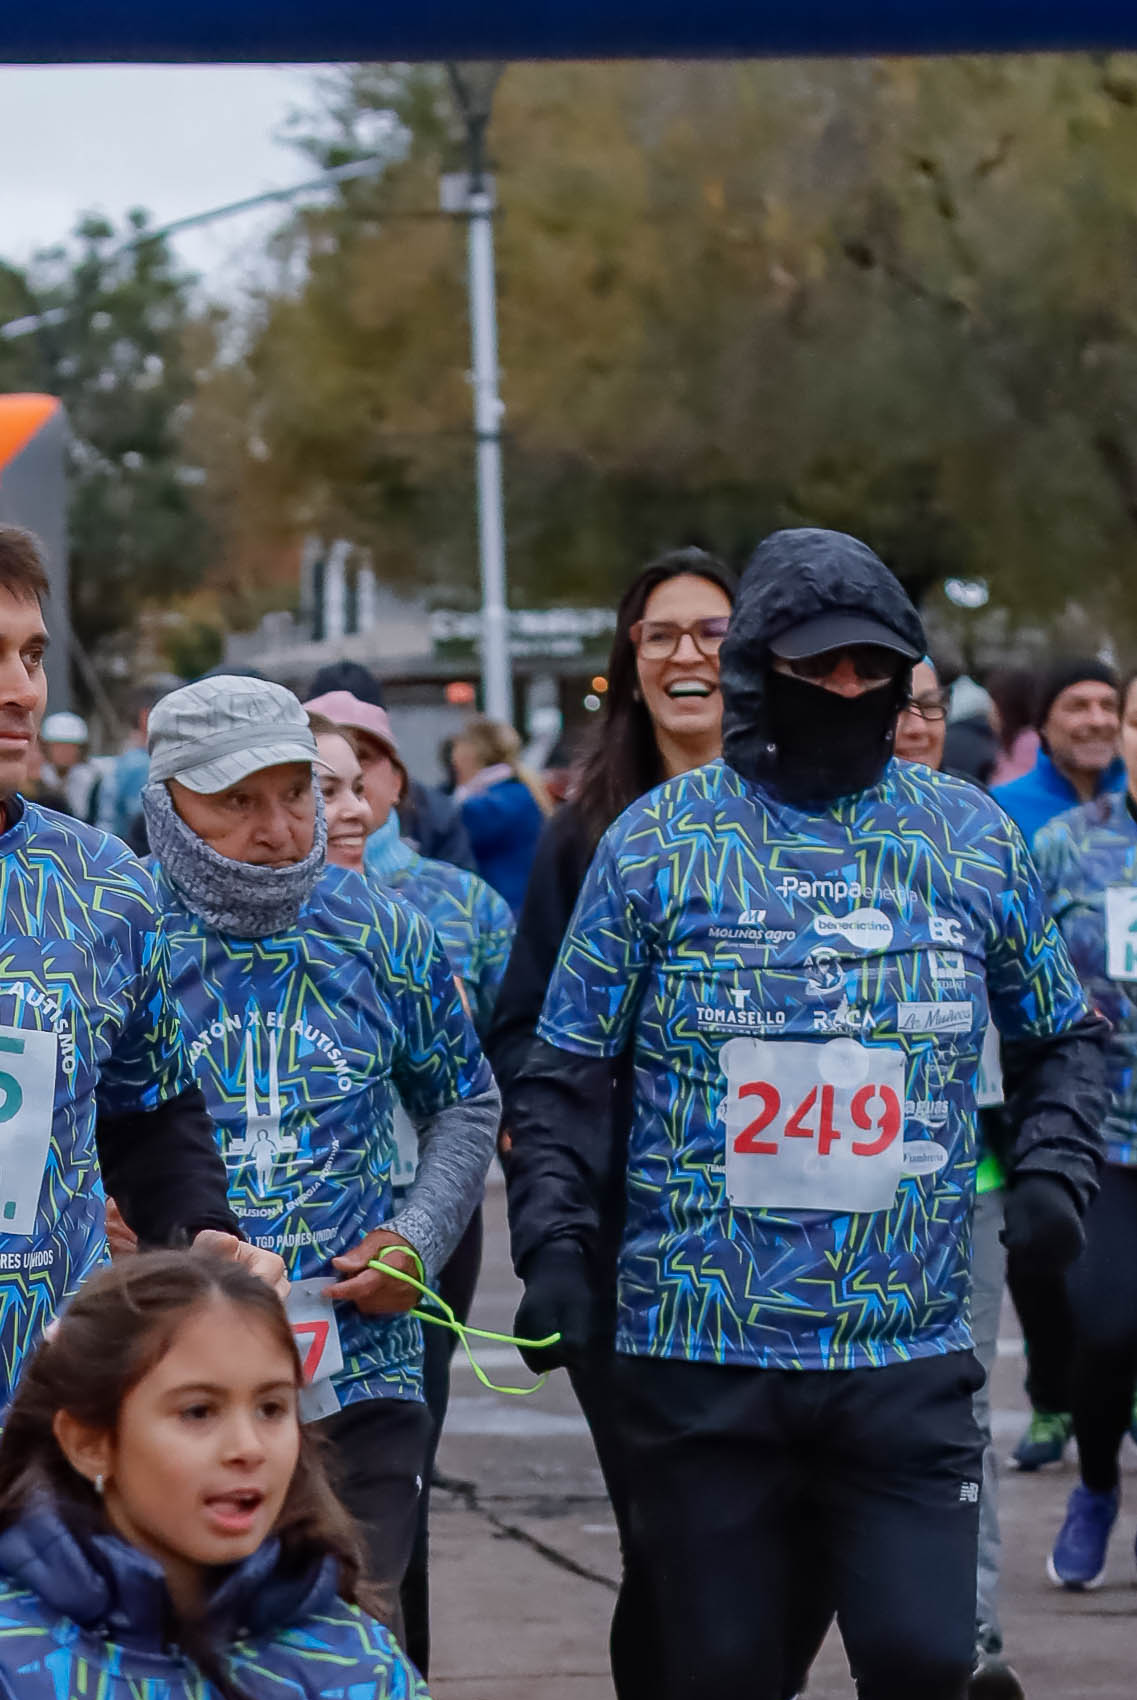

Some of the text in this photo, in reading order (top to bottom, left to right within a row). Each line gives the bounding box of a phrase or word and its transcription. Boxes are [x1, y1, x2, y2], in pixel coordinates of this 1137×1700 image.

[776, 876, 861, 903] Pampa
[708, 928, 796, 943] MOLINOS agro
[8, 981, 77, 1075] AUTISMO
[696, 1006, 785, 1025] TOMASELLO
[247, 1010, 261, 1027] X
[266, 1011, 286, 1029] EL
[290, 1019, 353, 1092] AUTISMO
[732, 1081, 901, 1157] 249
[255, 1235, 274, 1248] TGD
[276, 1232, 312, 1248] PADRES
